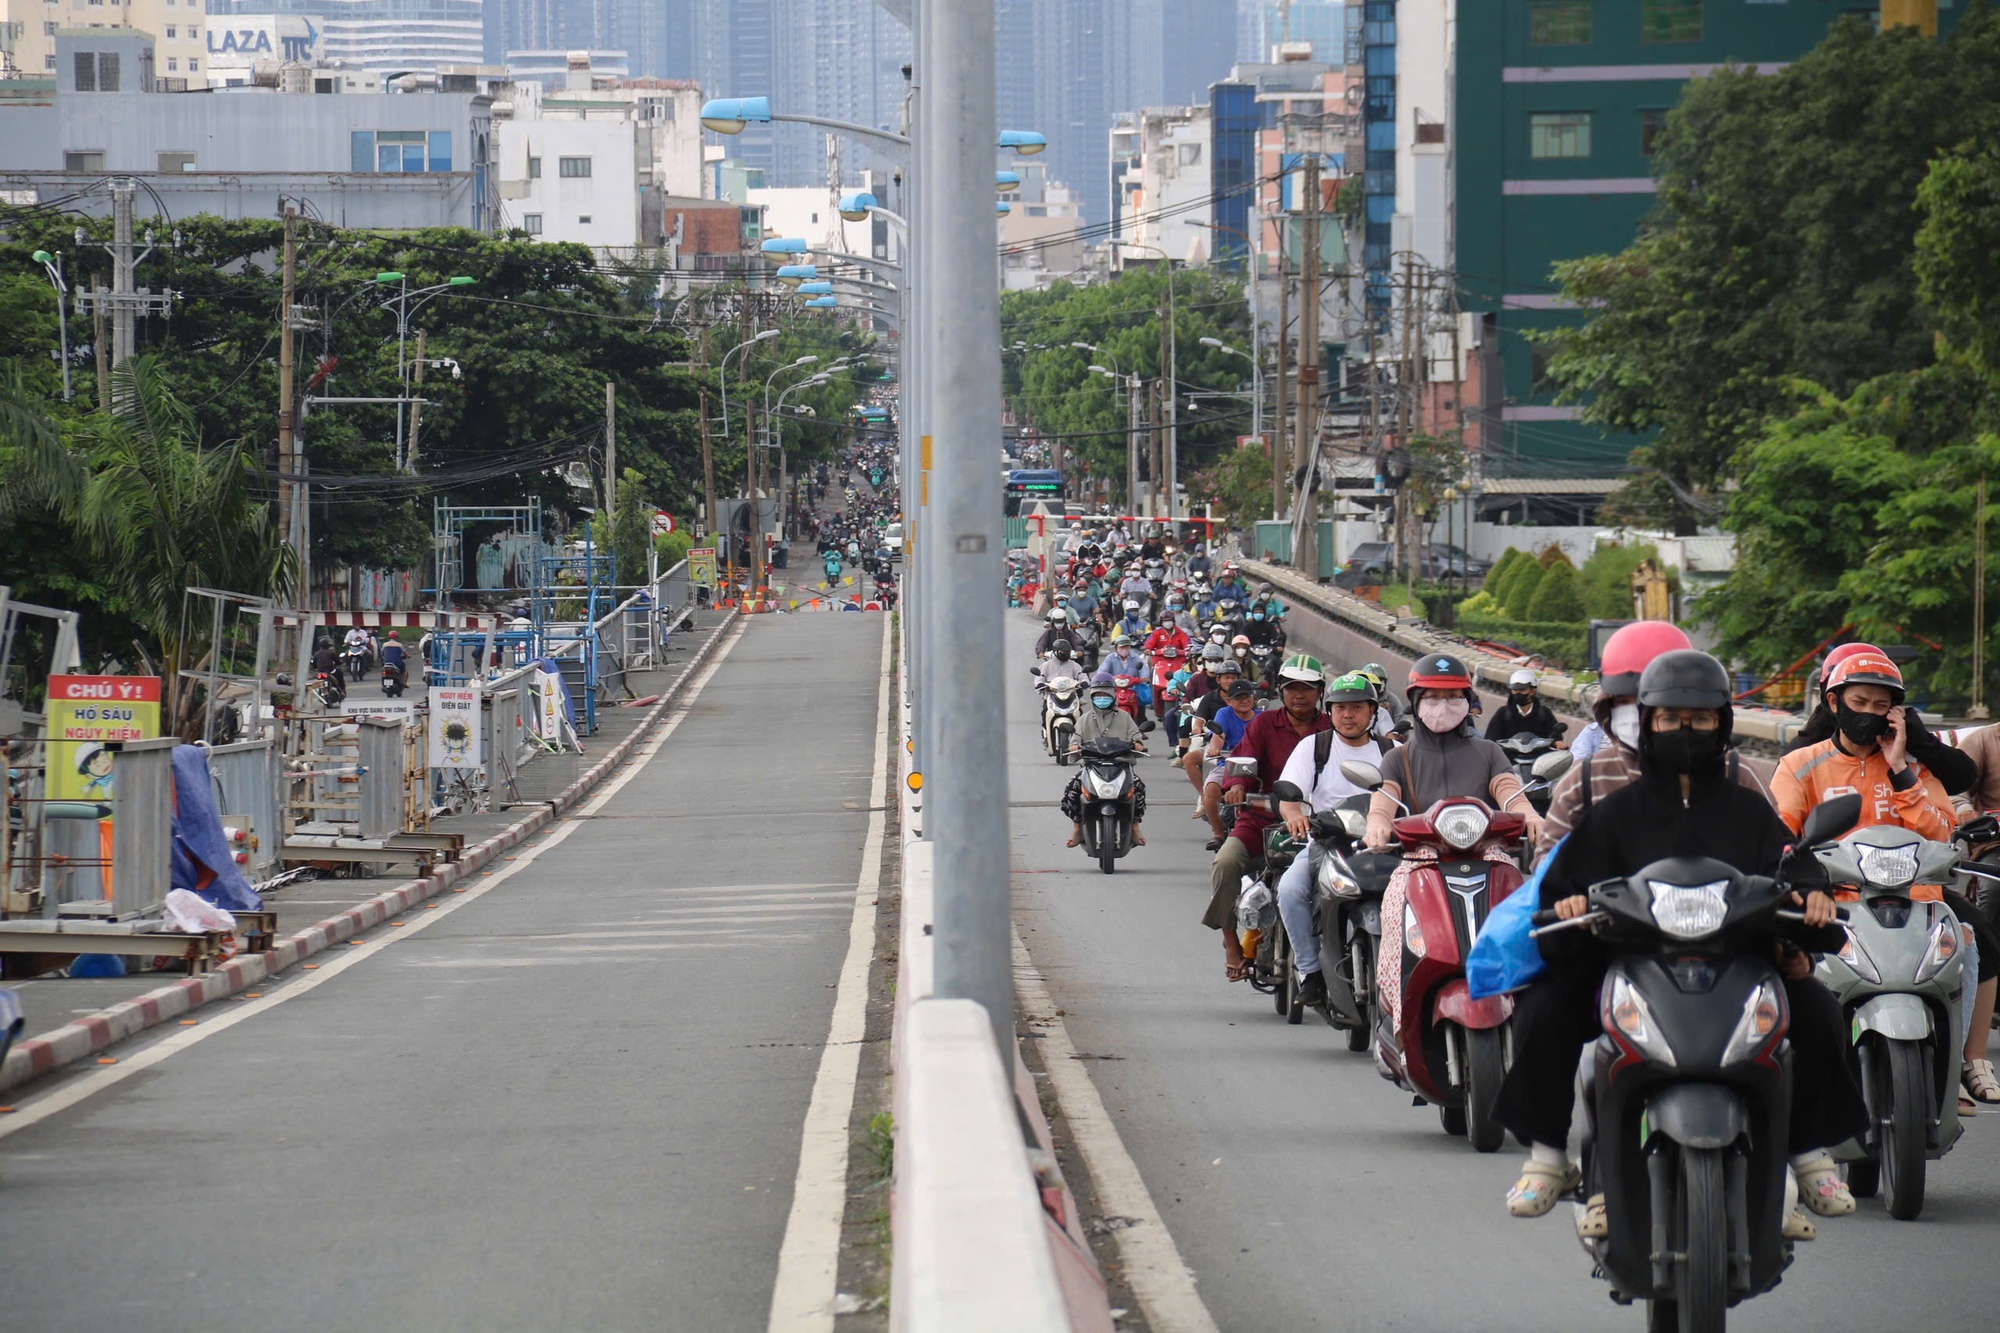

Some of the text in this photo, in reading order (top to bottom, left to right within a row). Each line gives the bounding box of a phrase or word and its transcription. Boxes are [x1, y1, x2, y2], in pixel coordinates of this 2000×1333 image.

[207, 30, 272, 52] LAZA
[66, 681, 142, 699] CHÚ Ý!
[440, 692, 456, 700] NGUY
[75, 704, 132, 721] HỐ SÂU
[65, 727, 103, 739] NGUY
[1873, 784, 1893, 798] Sh
[1874, 799, 1900, 820] Fo
